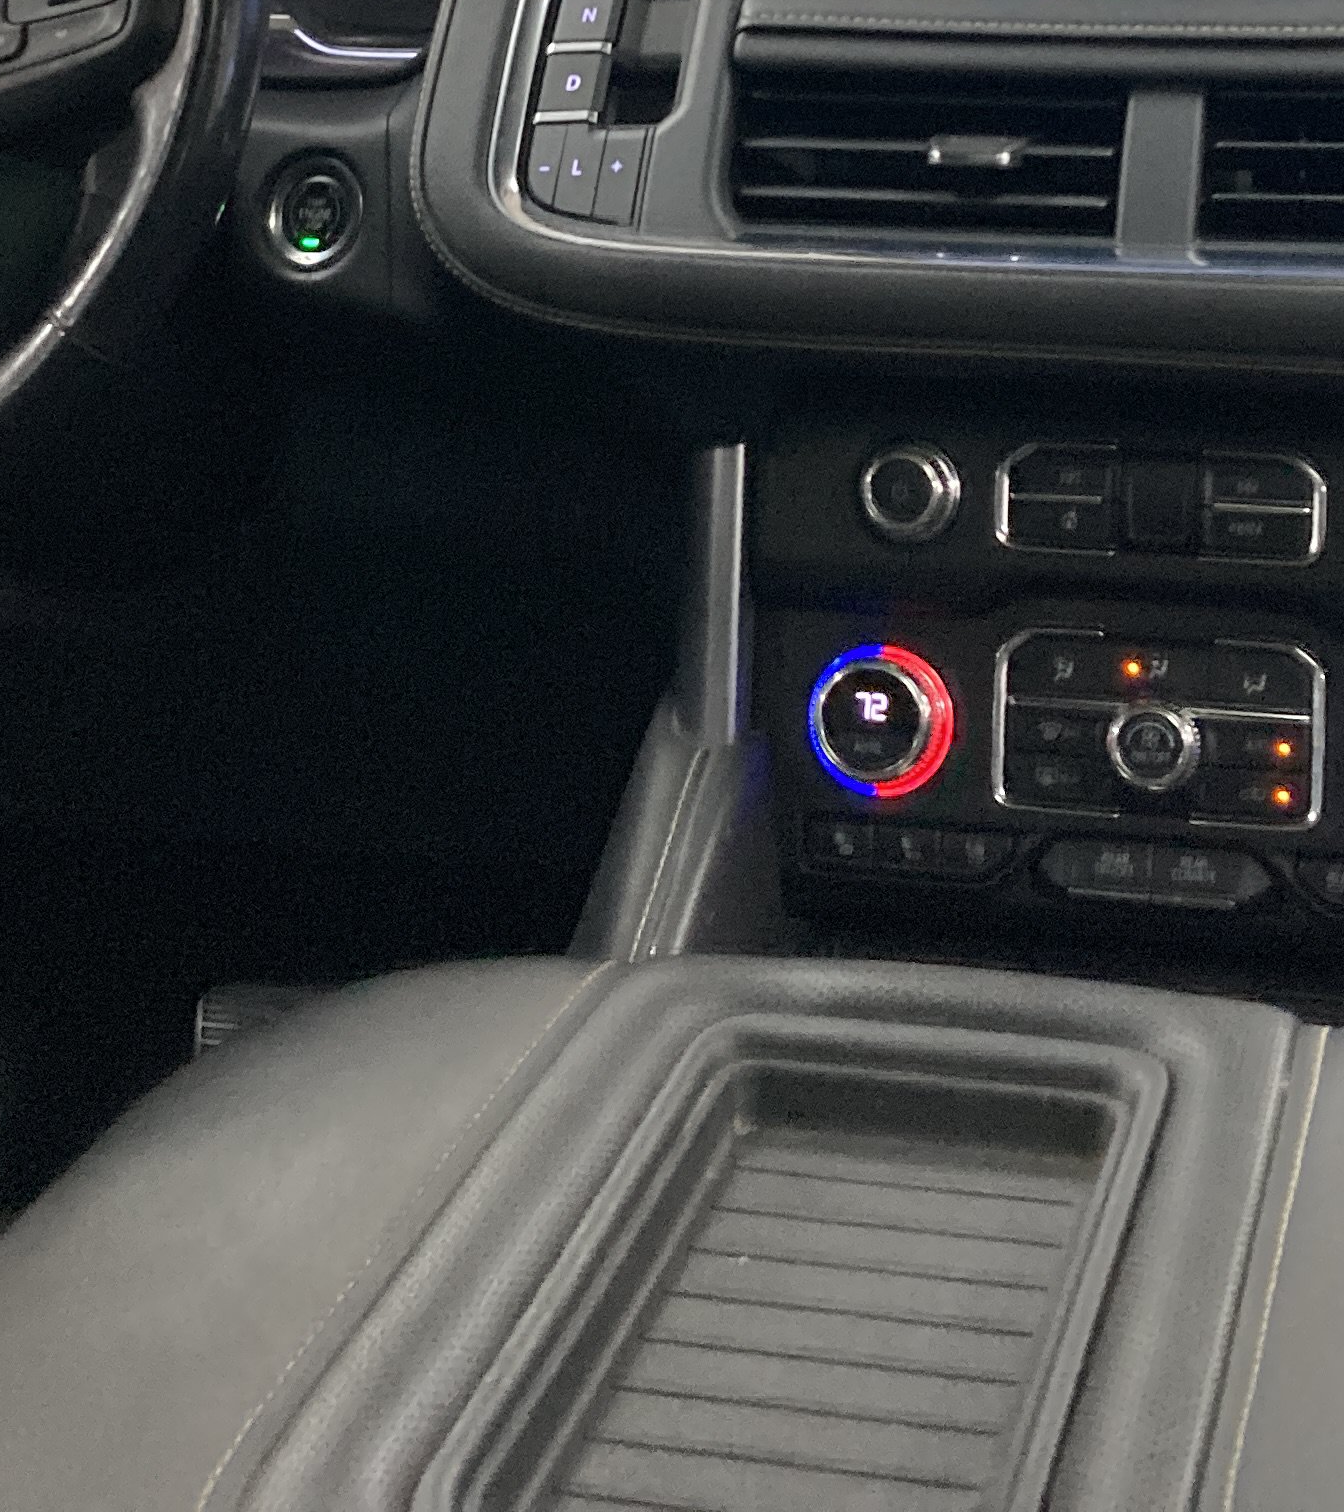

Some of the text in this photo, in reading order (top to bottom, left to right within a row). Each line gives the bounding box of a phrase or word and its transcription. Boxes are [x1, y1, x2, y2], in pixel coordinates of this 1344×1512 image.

[581, 8, 599, 23] N
[565, 74, 582, 92] D
[570, 159, 583, 177] L
[854, 691, 890, 723] 72
